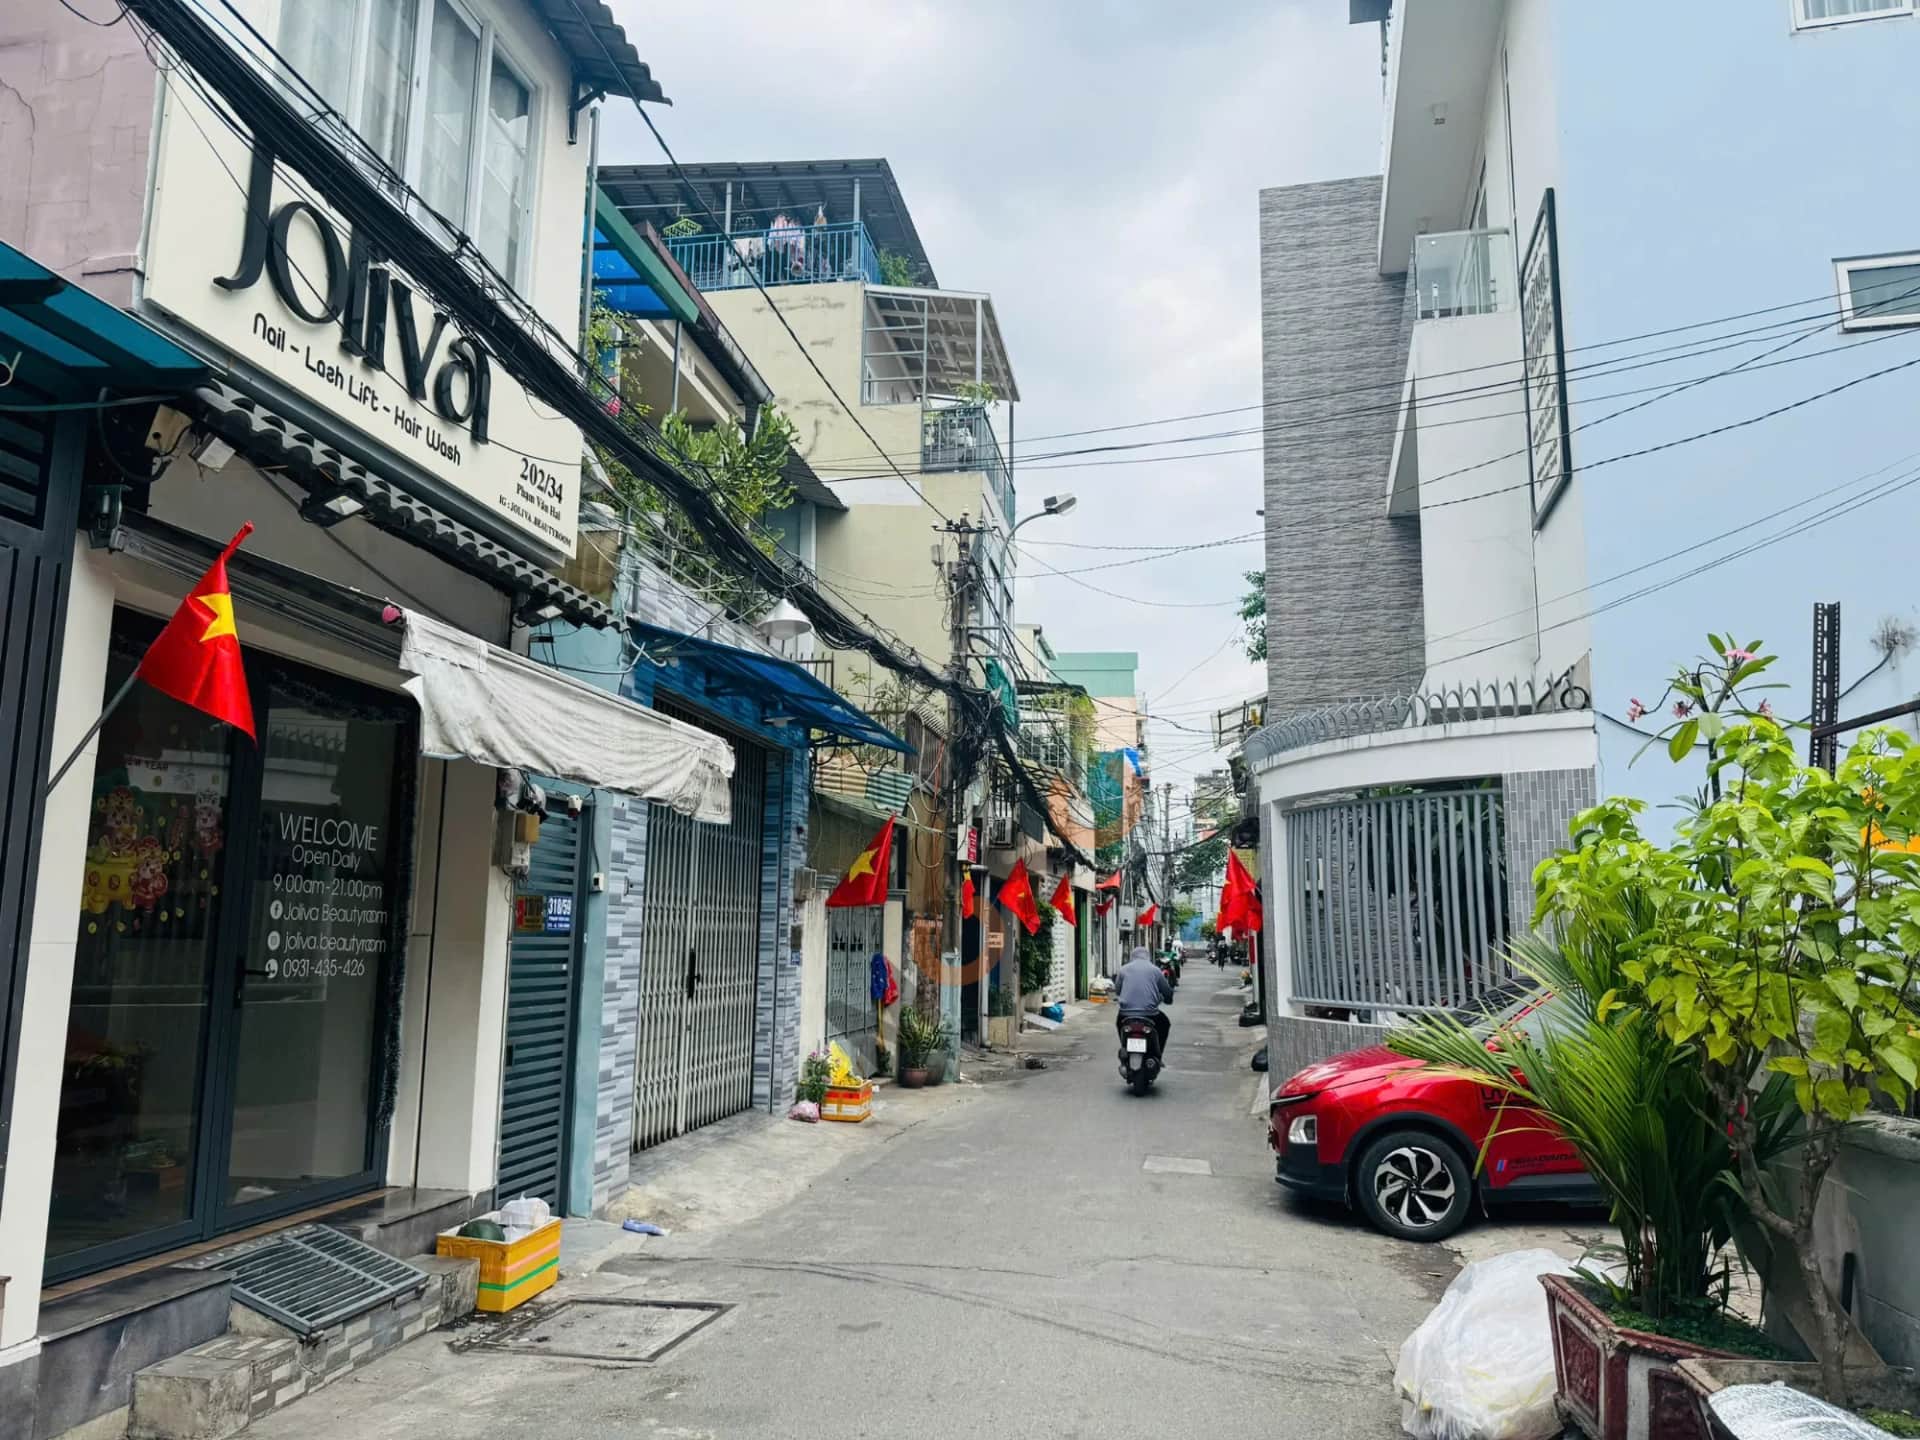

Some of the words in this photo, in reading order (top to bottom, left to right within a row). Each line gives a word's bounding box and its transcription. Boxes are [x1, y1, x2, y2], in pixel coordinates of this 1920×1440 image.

[305, 346, 344, 390] Lash
[348, 375, 378, 412] Lift
[394, 405, 423, 439] Hair
[426, 426, 461, 466] Wash
[520, 457, 563, 504] 202/34
[279, 811, 378, 851] WELCOME
[292, 844, 330, 867] Open
[332, 850, 361, 872] Daily
[283, 902, 319, 921] Joliva
[321, 903, 387, 927] Beautyroom
[283, 959, 365, 978] 0931-435-426
